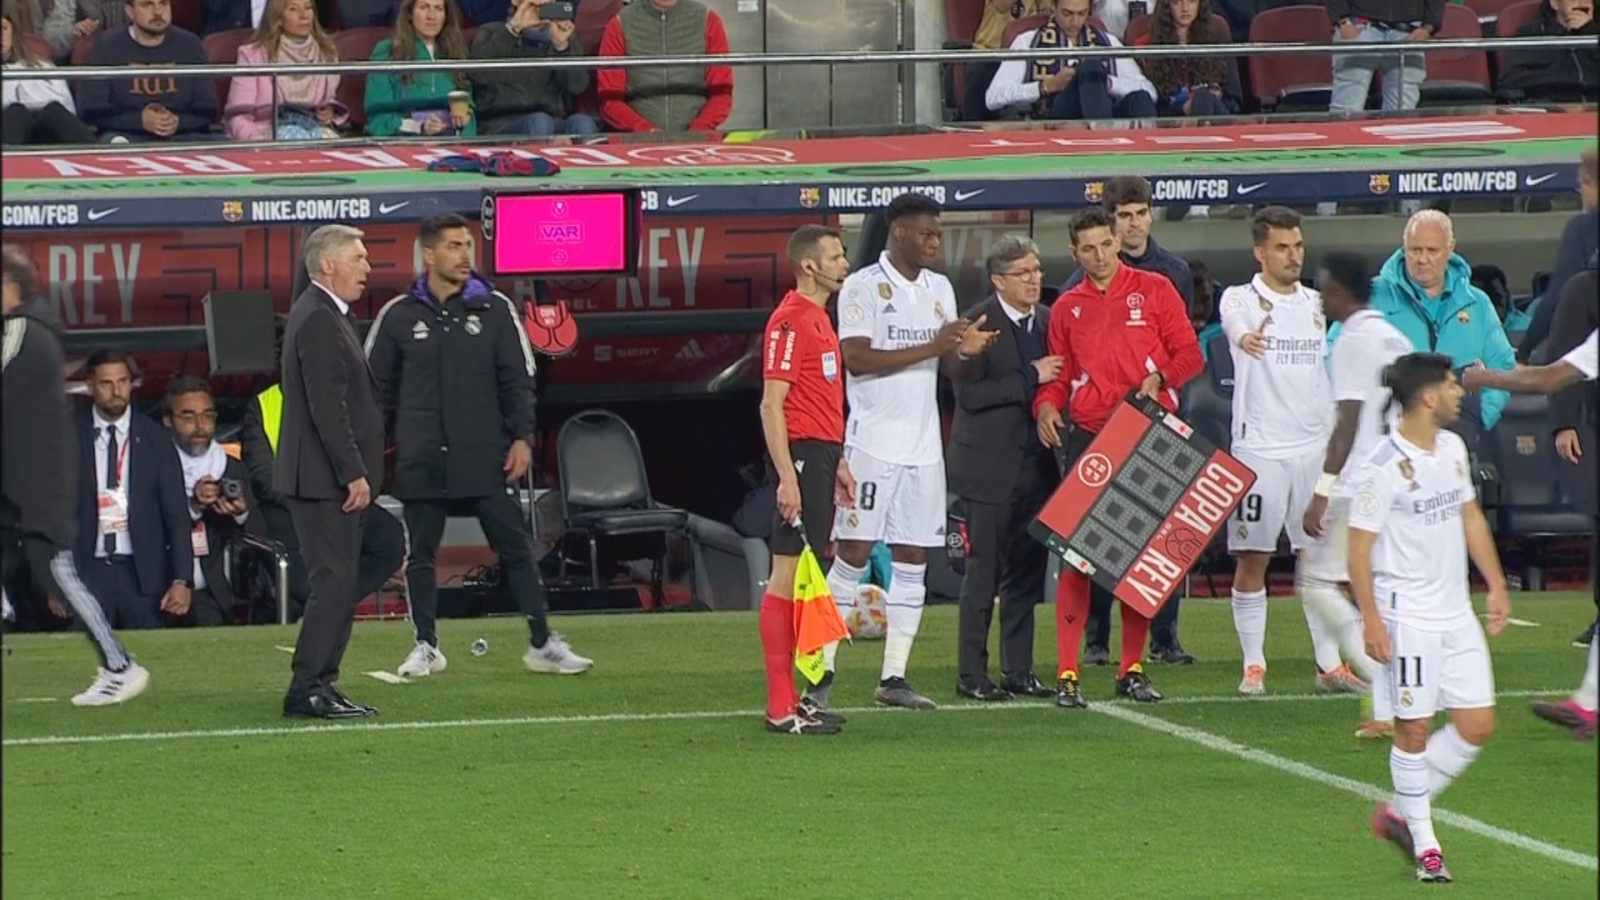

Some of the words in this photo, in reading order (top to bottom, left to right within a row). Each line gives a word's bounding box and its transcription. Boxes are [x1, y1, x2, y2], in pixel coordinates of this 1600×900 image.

[1151, 178, 1229, 200] .COM/FCB
[1398, 170, 1517, 193] NIKE.COM/FCB
[252, 198, 371, 221] NIKE.COM/FCB
[541, 225, 580, 238] VAR
[48, 243, 141, 325] REY
[1174, 462, 1244, 535] COPA
[1125, 548, 1182, 607] REY
[1398, 656, 1424, 687] 11
